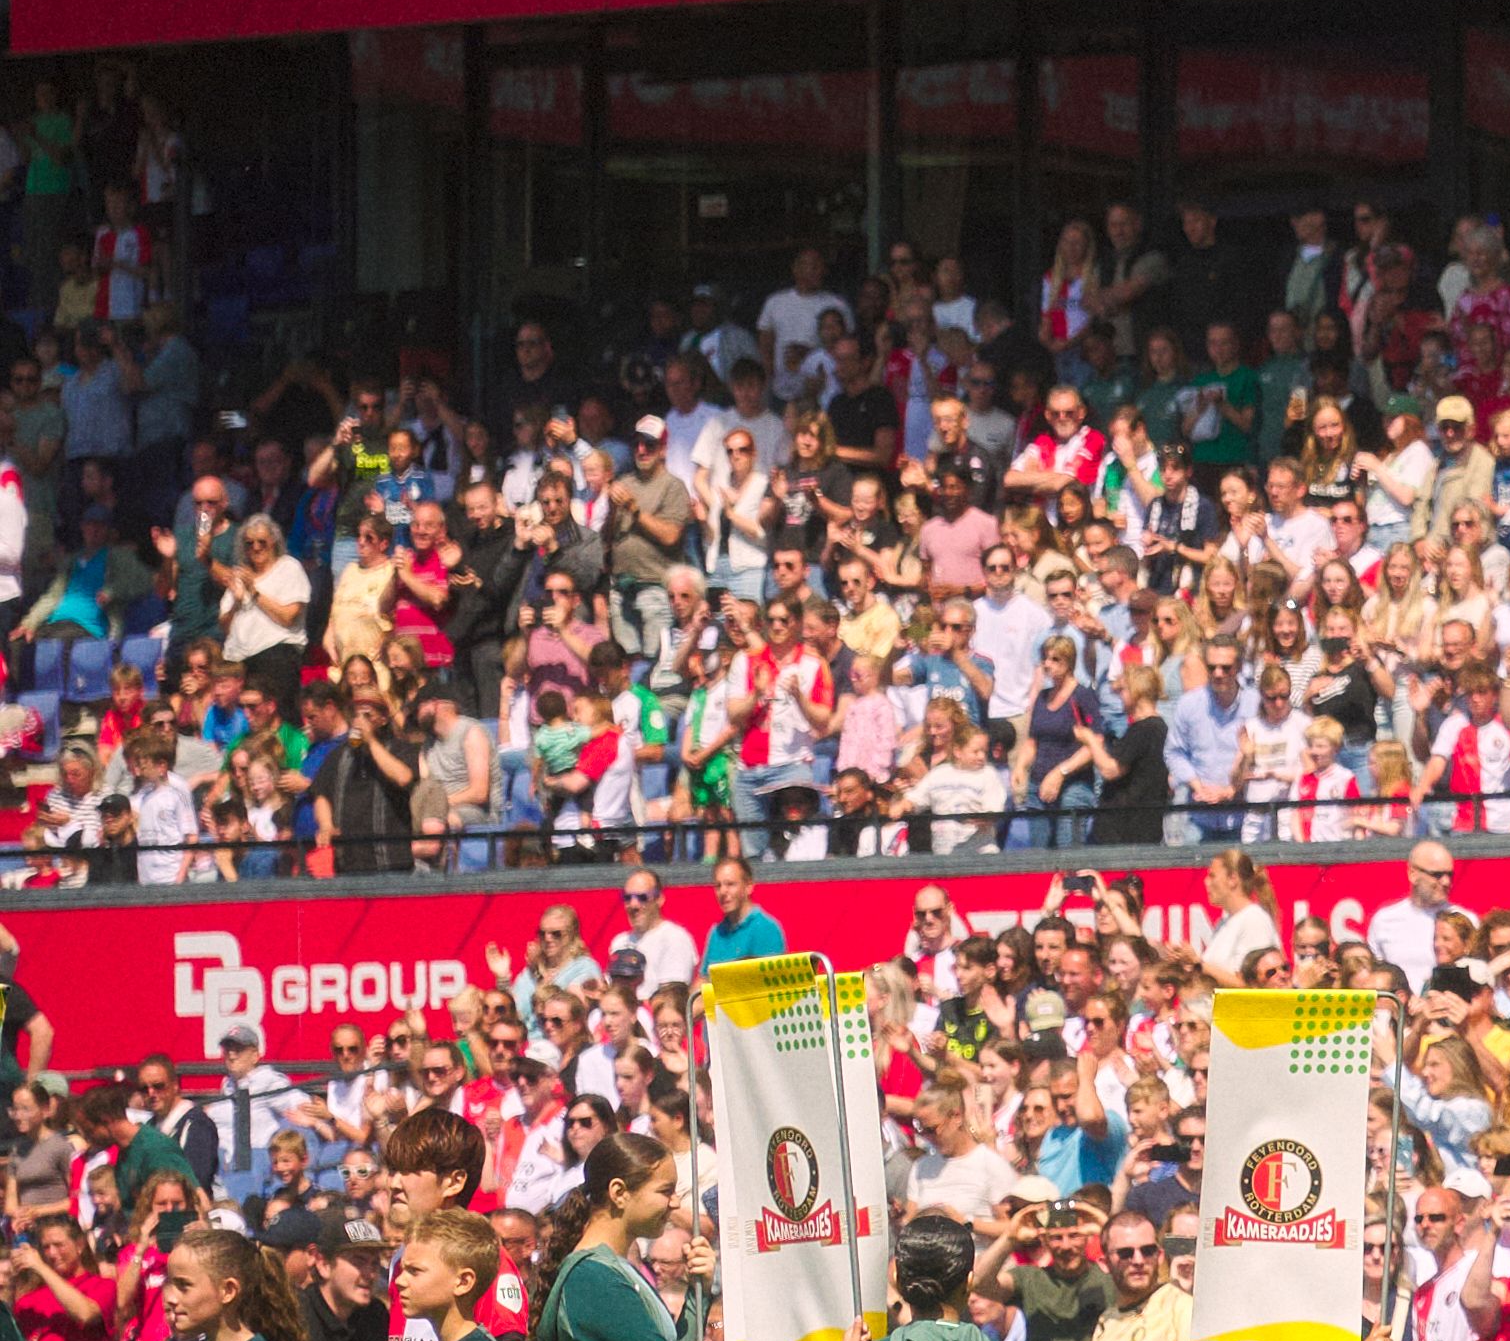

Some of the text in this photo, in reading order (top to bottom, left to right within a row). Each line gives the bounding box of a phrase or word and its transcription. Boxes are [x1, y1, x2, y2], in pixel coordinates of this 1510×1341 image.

[272, 959, 468, 1017] GROUP
[1246, 1141, 1318, 1171] FEYENOORD
[1243, 1192, 1318, 1222] ROTTERDAM
[764, 1208, 832, 1243] KAMERAADJES
[1226, 1213, 1333, 1241] KAMERAADJES
